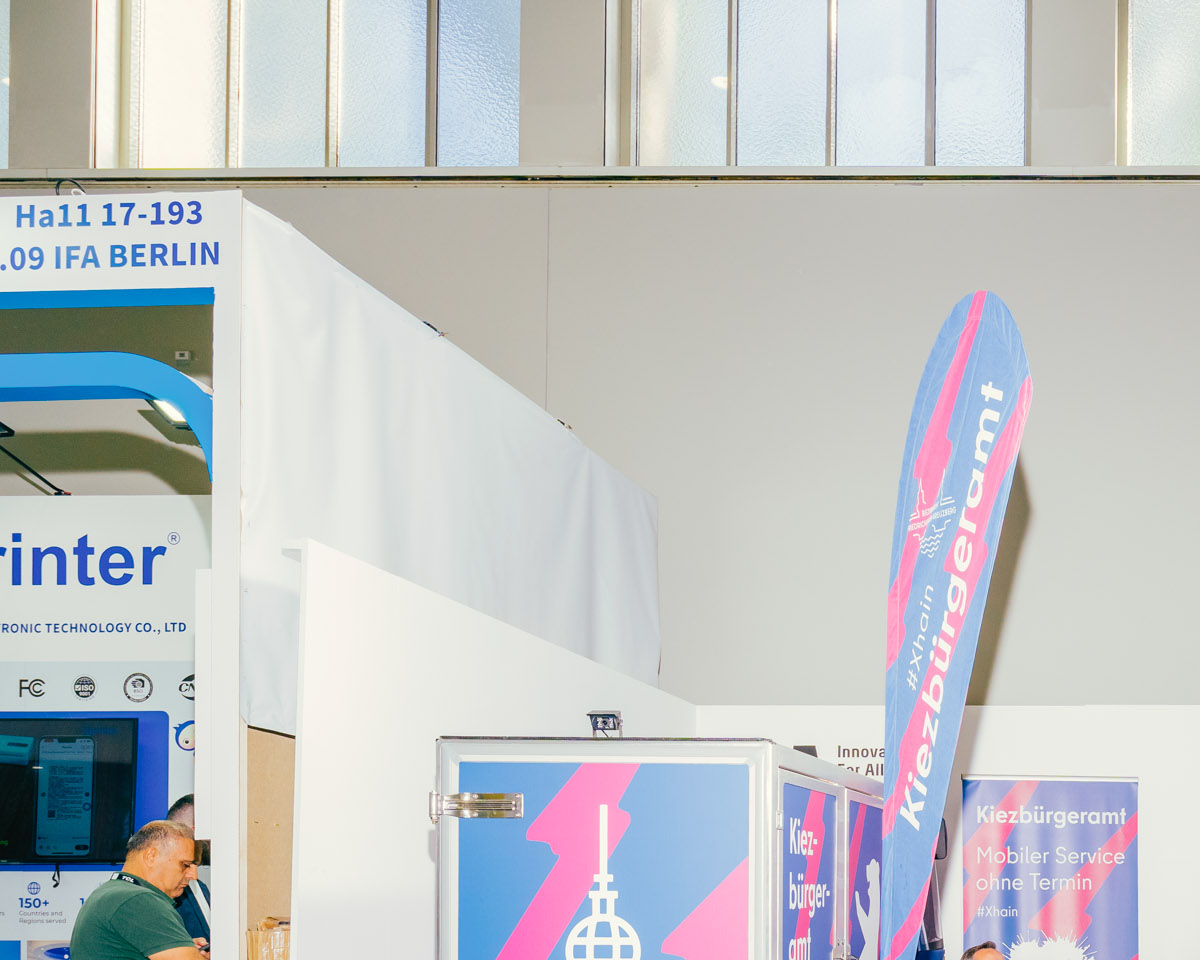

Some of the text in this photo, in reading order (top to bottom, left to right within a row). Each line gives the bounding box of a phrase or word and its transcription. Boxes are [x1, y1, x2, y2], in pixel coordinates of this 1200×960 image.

[101, 201, 203, 226] 17-193
[55, 245, 100, 269] IFA
[110, 242, 219, 267] BERLIN
[0, 533, 167, 586] inter
[900, 381, 1004, 831] Kiezbürgeramt
[0, 622, 187, 635] RONIC TECHNOLOGY CO., LTD
[906, 584, 934, 691] #Xhain
[178, 683, 195, 693] CN
[976, 806, 1127, 828] Kiezbürgeramt
[789, 817, 818, 856] Kiez-
[977, 846, 1126, 865] Mobiler Service
[976, 873, 1092, 891] ohne Termin
[19, 898, 49, 909] 150+
[789, 872, 830, 918] bürger-
[977, 906, 1019, 918] #Xhain
